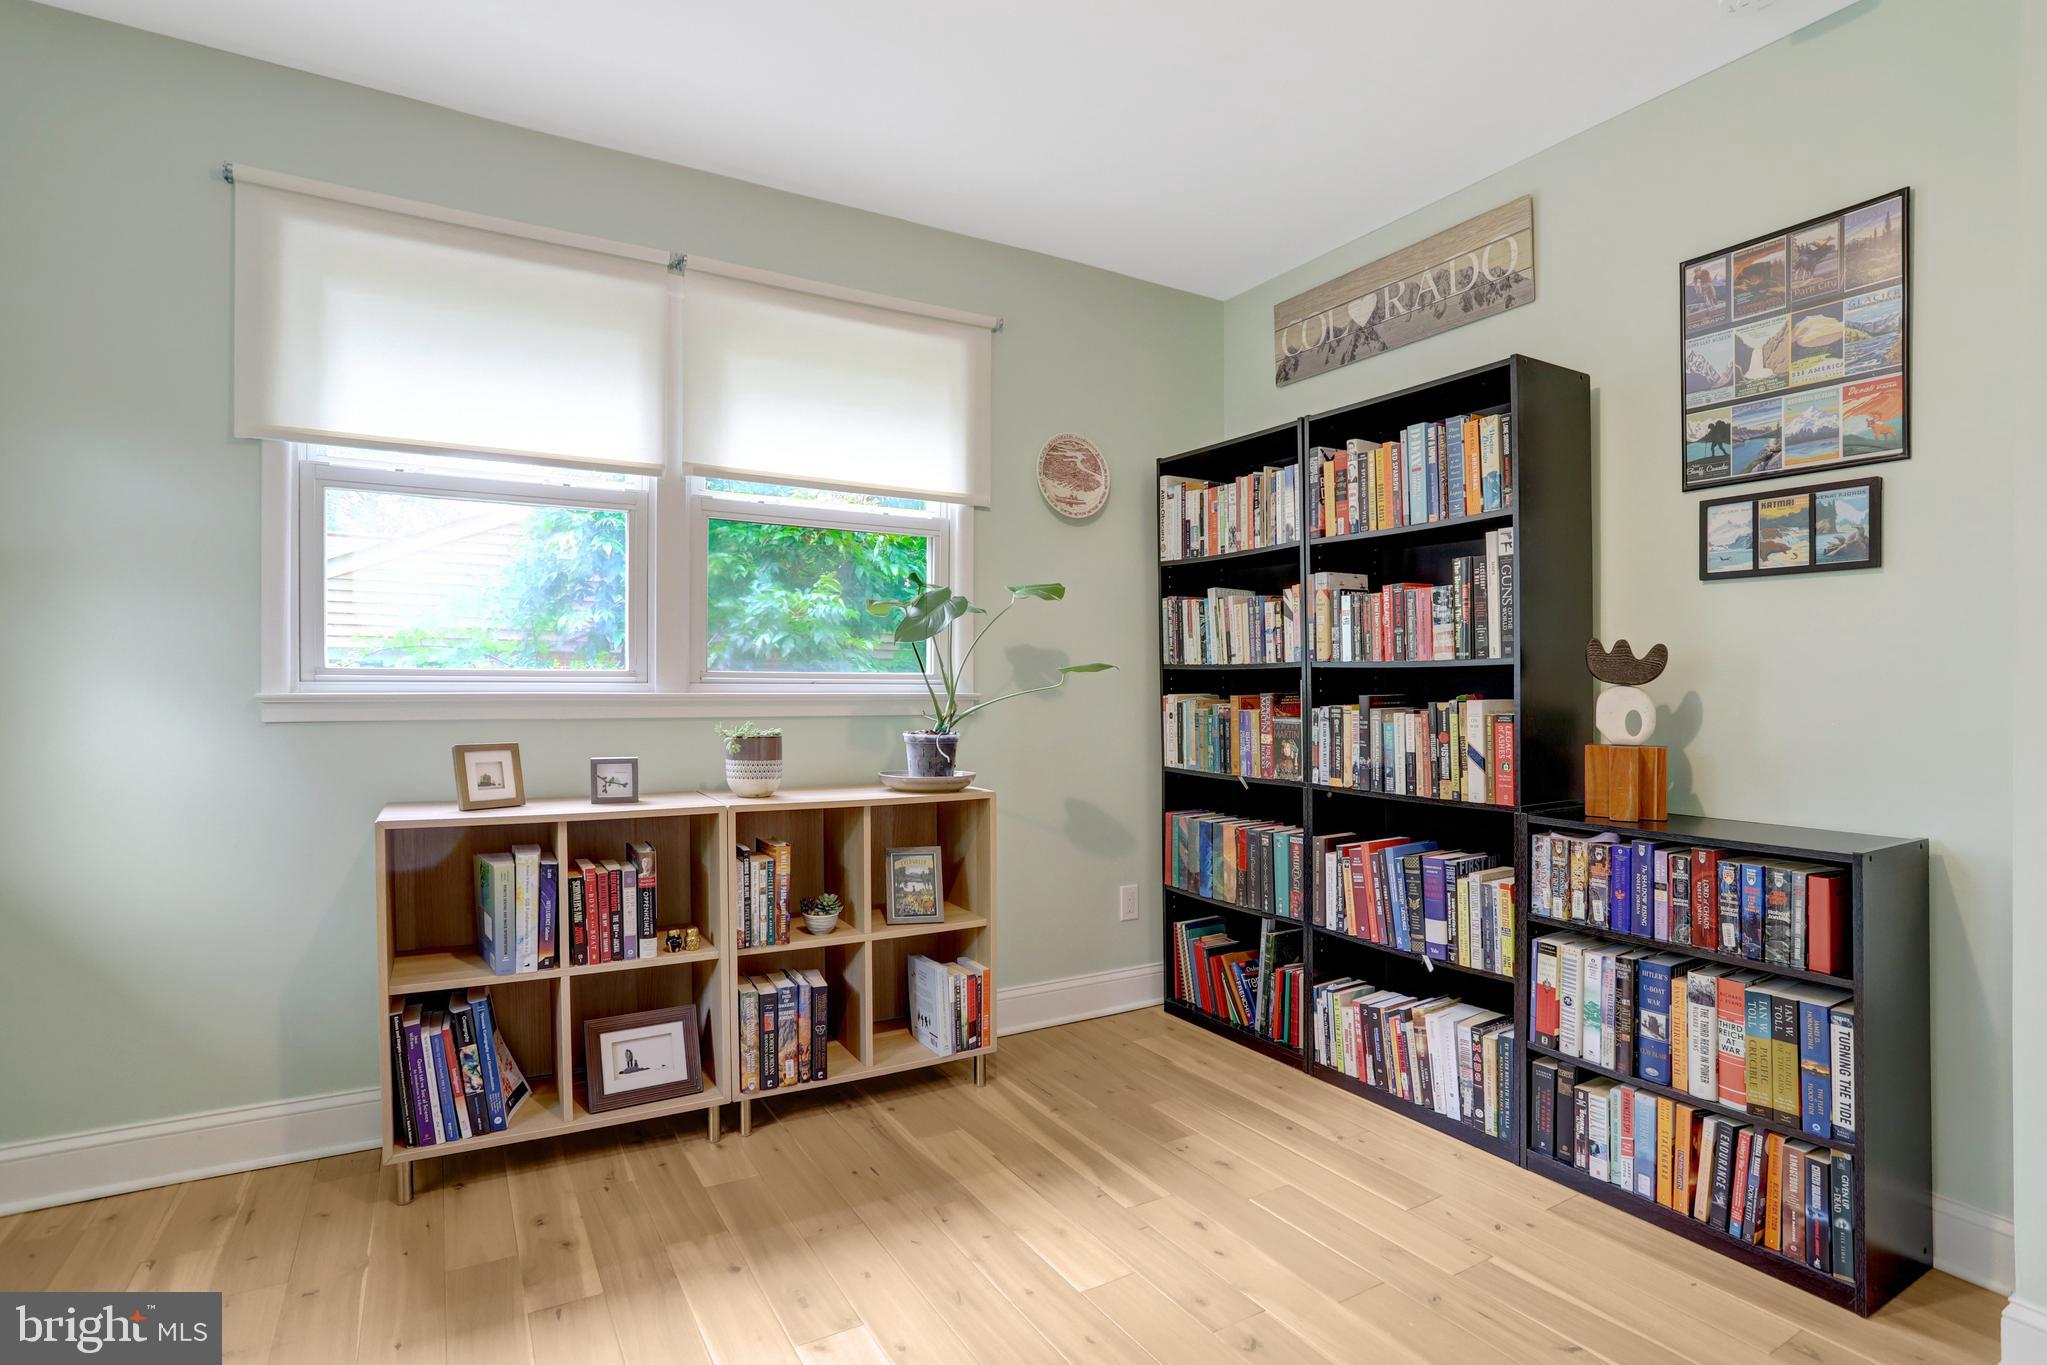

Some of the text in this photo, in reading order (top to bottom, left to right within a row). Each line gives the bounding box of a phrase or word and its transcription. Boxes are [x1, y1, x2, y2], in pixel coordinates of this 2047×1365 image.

[1808, 361, 1843, 375] AMERICA
[1760, 498, 1794, 510] KATMAI
[1501, 564, 1512, 605] GUNS
[1454, 610, 1462, 621] The
[1507, 607, 1512, 615] OF
[1293, 850, 1301, 892] MURTAGH
[1447, 866, 1456, 882] FIRST
[1397, 878, 1405, 905] TERRORISM
[1641, 970, 1669, 982] HITLER'S
[1643, 985, 1665, 996] U-BOAT
[1647, 998, 1662, 1008] WAR
[1700, 1008, 1709, 1019] THE
[1622, 1008, 1631, 1032] AT THE
[1747, 1001, 1757, 1027] TOLL
[1758, 1000, 1768, 1033] IAN W.
[1774, 1005, 1782, 1032] TOLL
[1784, 1004, 1794, 1037] IAN W.
[461, 1016, 470, 1042] Cartography
[1700, 1021, 1709, 1037] THIRD
[1718, 1028, 1745, 1041] REICH
[1719, 1021, 1743, 1032] THIRD
[1813, 1019, 1821, 1037] JAMES
[481, 1030, 490, 1053] Cartography
[1700, 1038, 1709, 1055] REICH
[1720, 1044, 1741, 1055] WAR
[1726, 1037, 1736, 1046] AT
[1777, 1042, 1784, 1052] OF
[1748, 1039, 1758, 1088] CRUCIBLE
[1839, 1031, 1851, 1075] TURNING
[1700, 1064, 1709, 1084] POWER
[1759, 1047, 1768, 1084] PACIFIC
[1784, 1050, 1792, 1091] TWILIGHT
[416, 1058, 425, 1088] Quantitative
[421, 1104, 430, 1122] Science
[451, 1068, 460, 1094] Intelligence
[1777, 1073, 1785, 1094] GODS
[1840, 1079, 1852, 1098] THE
[1840, 1102, 1852, 1125] TIDE
[1661, 1129, 1669, 1180] STALINGRAD
[1715, 1134, 1730, 1189] ENDURANCE
[1789, 1154, 1798, 1193] ARMAGEDDON
[1811, 1165, 1821, 1186] CITIZEN
[1841, 1174, 1850, 1210] GIVEN UP
[1745, 1201, 1754, 1222] KEITH
[1833, 1193, 1841, 1213] DEAD
